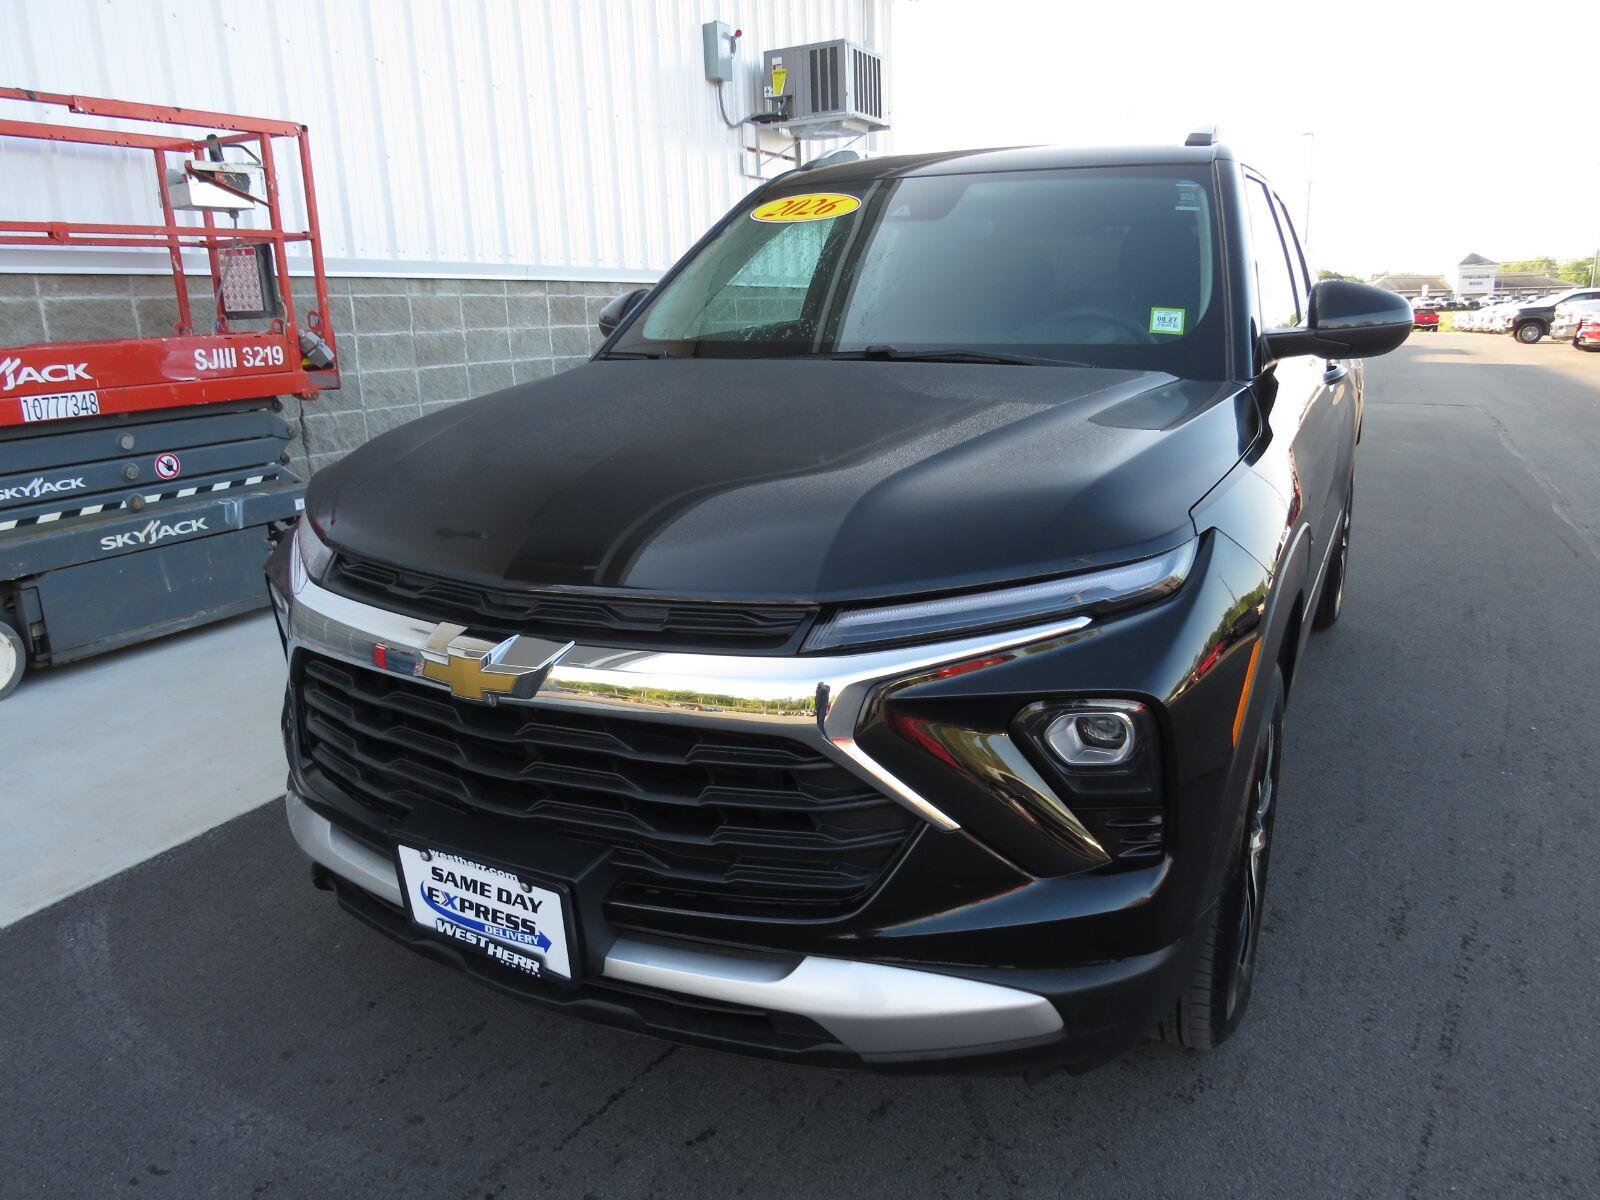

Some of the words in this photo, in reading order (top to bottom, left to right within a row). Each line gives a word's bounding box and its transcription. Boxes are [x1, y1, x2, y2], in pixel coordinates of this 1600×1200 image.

[762, 198, 848, 218] 2026
[242, 345, 284, 368] 3219
[22, 392, 98, 420] 10777348
[100, 518, 209, 550] SKYJACK
[431, 866, 492, 899] SAME
[497, 887, 543, 914] DAY
[427, 886, 537, 935] EXPRESS
[484, 925, 539, 945] DELIVERY
